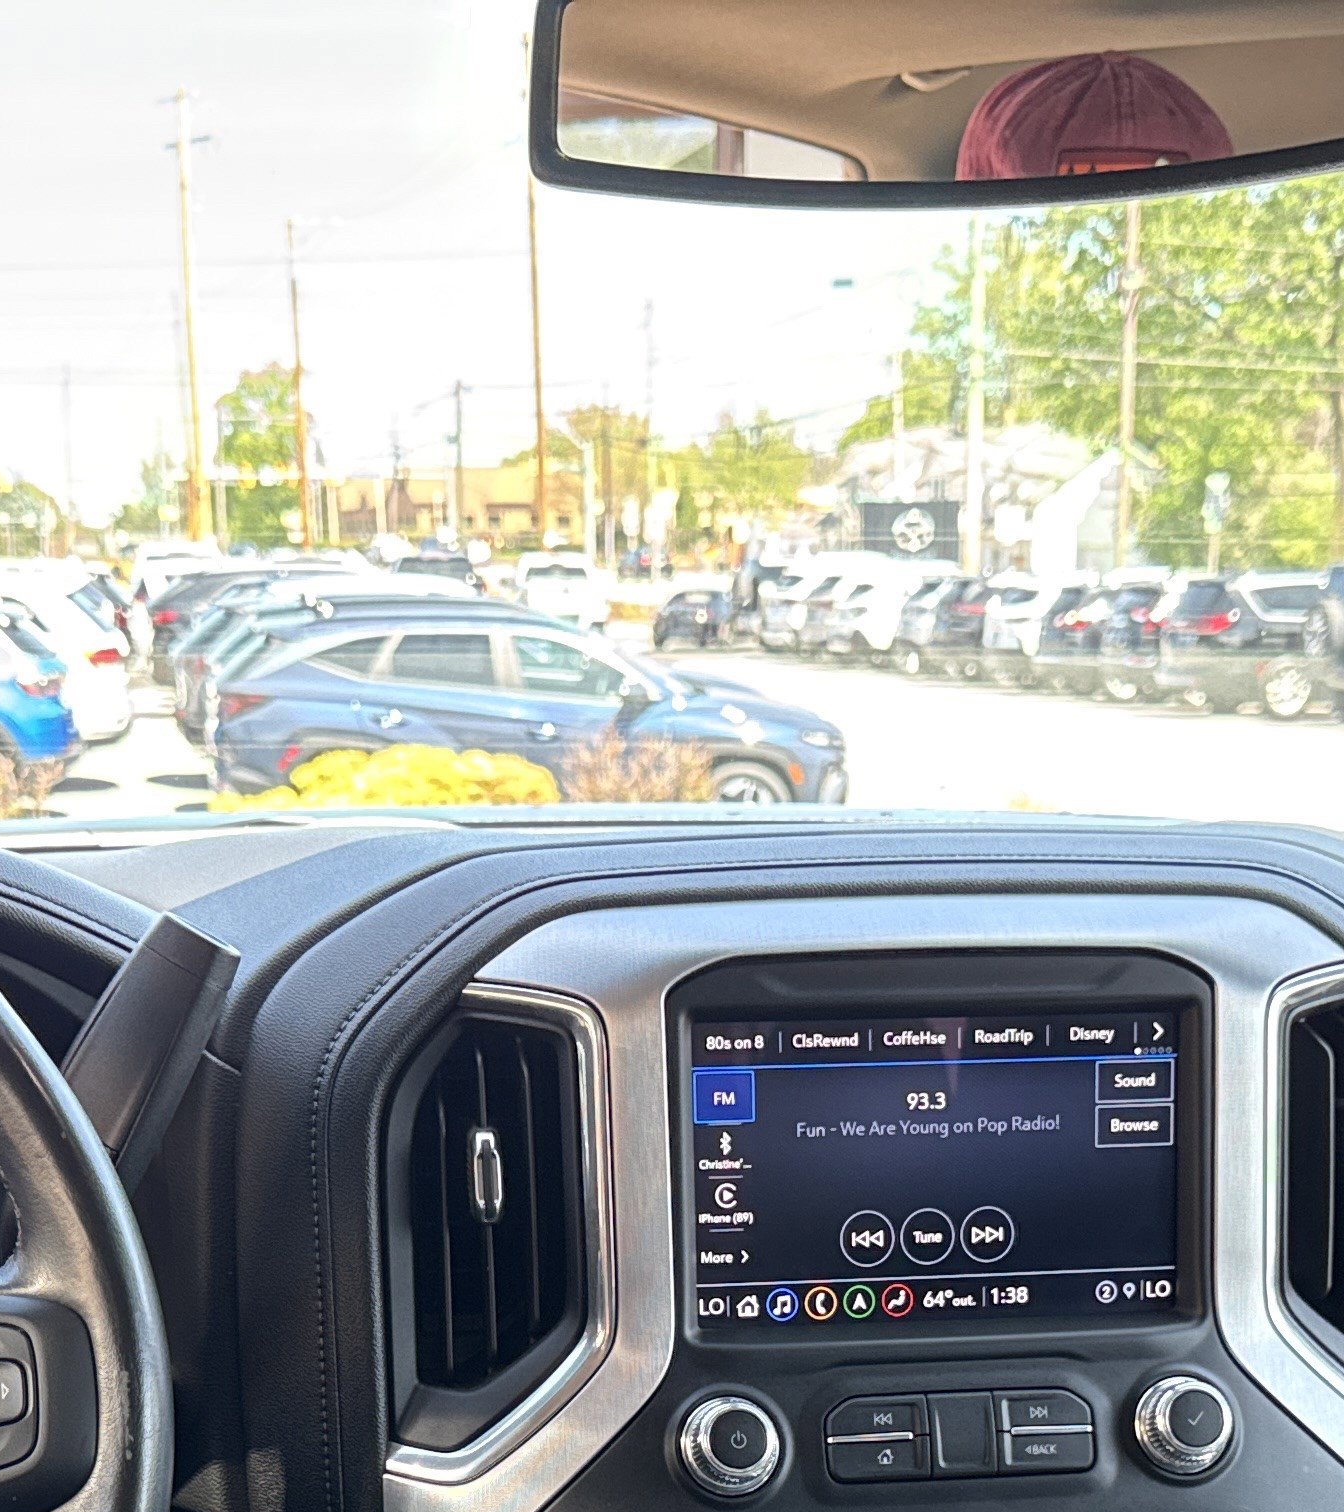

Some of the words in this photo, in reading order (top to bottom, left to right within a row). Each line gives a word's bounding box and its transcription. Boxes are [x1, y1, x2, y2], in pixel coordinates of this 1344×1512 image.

[706, 1036, 732, 1050] 80s
[734, 1039, 752, 1050] on
[754, 1035, 764, 1049] 8
[883, 1031, 947, 1046] CoffeHse
[974, 1028, 1034, 1046] RoadTrip
[1070, 1027, 1115, 1043] Disney
[1114, 1072, 1156, 1087] Sound
[713, 1092, 735, 1105] FM
[906, 1092, 947, 1110] 93.3
[796, 1122, 826, 1138] Fun
[840, 1121, 865, 1136] We
[868, 1121, 896, 1136] Are
[899, 1120, 949, 1138] Young
[953, 1121, 973, 1133] on
[978, 1117, 1007, 1135] Pop
[1011, 1114, 1060, 1131] Radio!
[1110, 1118, 1159, 1132] Browse
[913, 1230, 943, 1243] Tune
[700, 1251, 734, 1264] More
[990, 1286, 1029, 1304] 1:38
[1146, 1280, 1171, 1298] LO
[699, 1297, 725, 1316] LO
[1031, 1444, 1057, 1455] BACK
